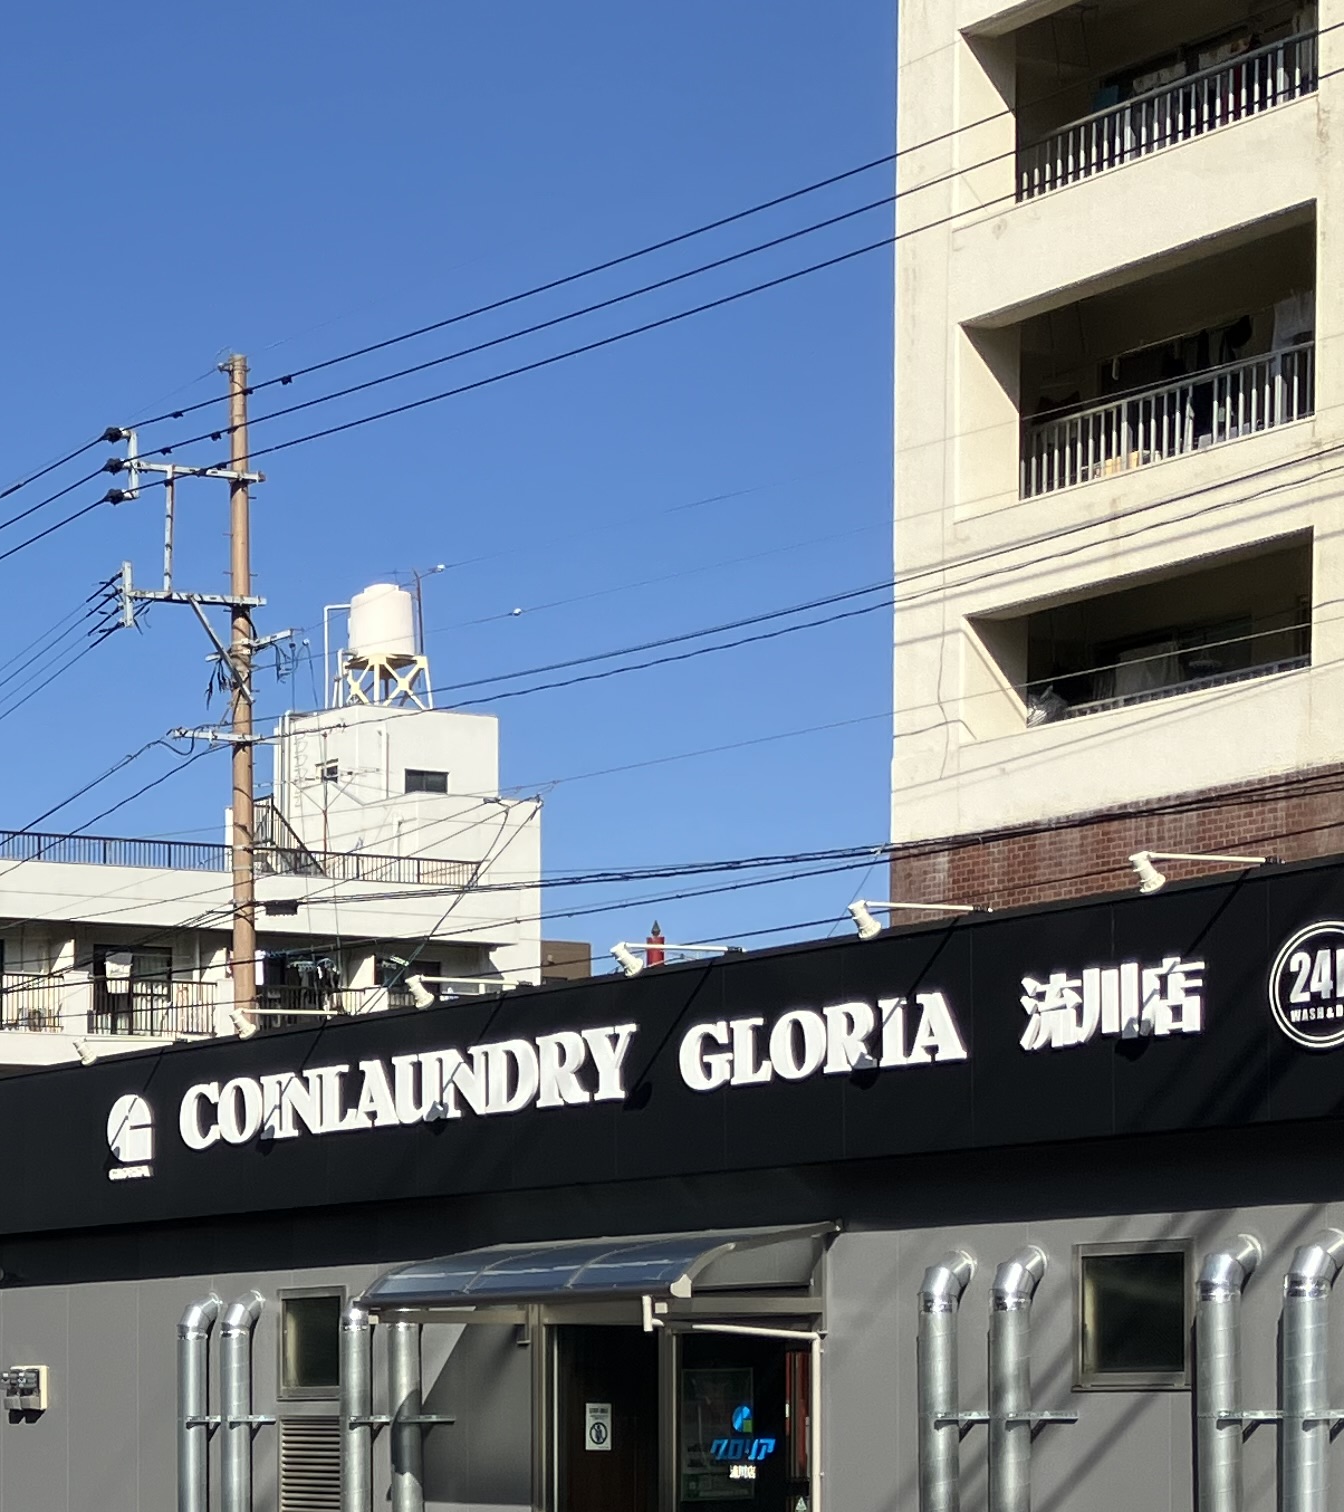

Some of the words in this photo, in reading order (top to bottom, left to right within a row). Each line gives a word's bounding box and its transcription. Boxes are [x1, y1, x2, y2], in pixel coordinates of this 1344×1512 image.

[179, 1022, 638, 1151] COINLAUNDRY
[679, 992, 968, 1091] GLORIA
[1020, 957, 1205, 1050] 流川店
